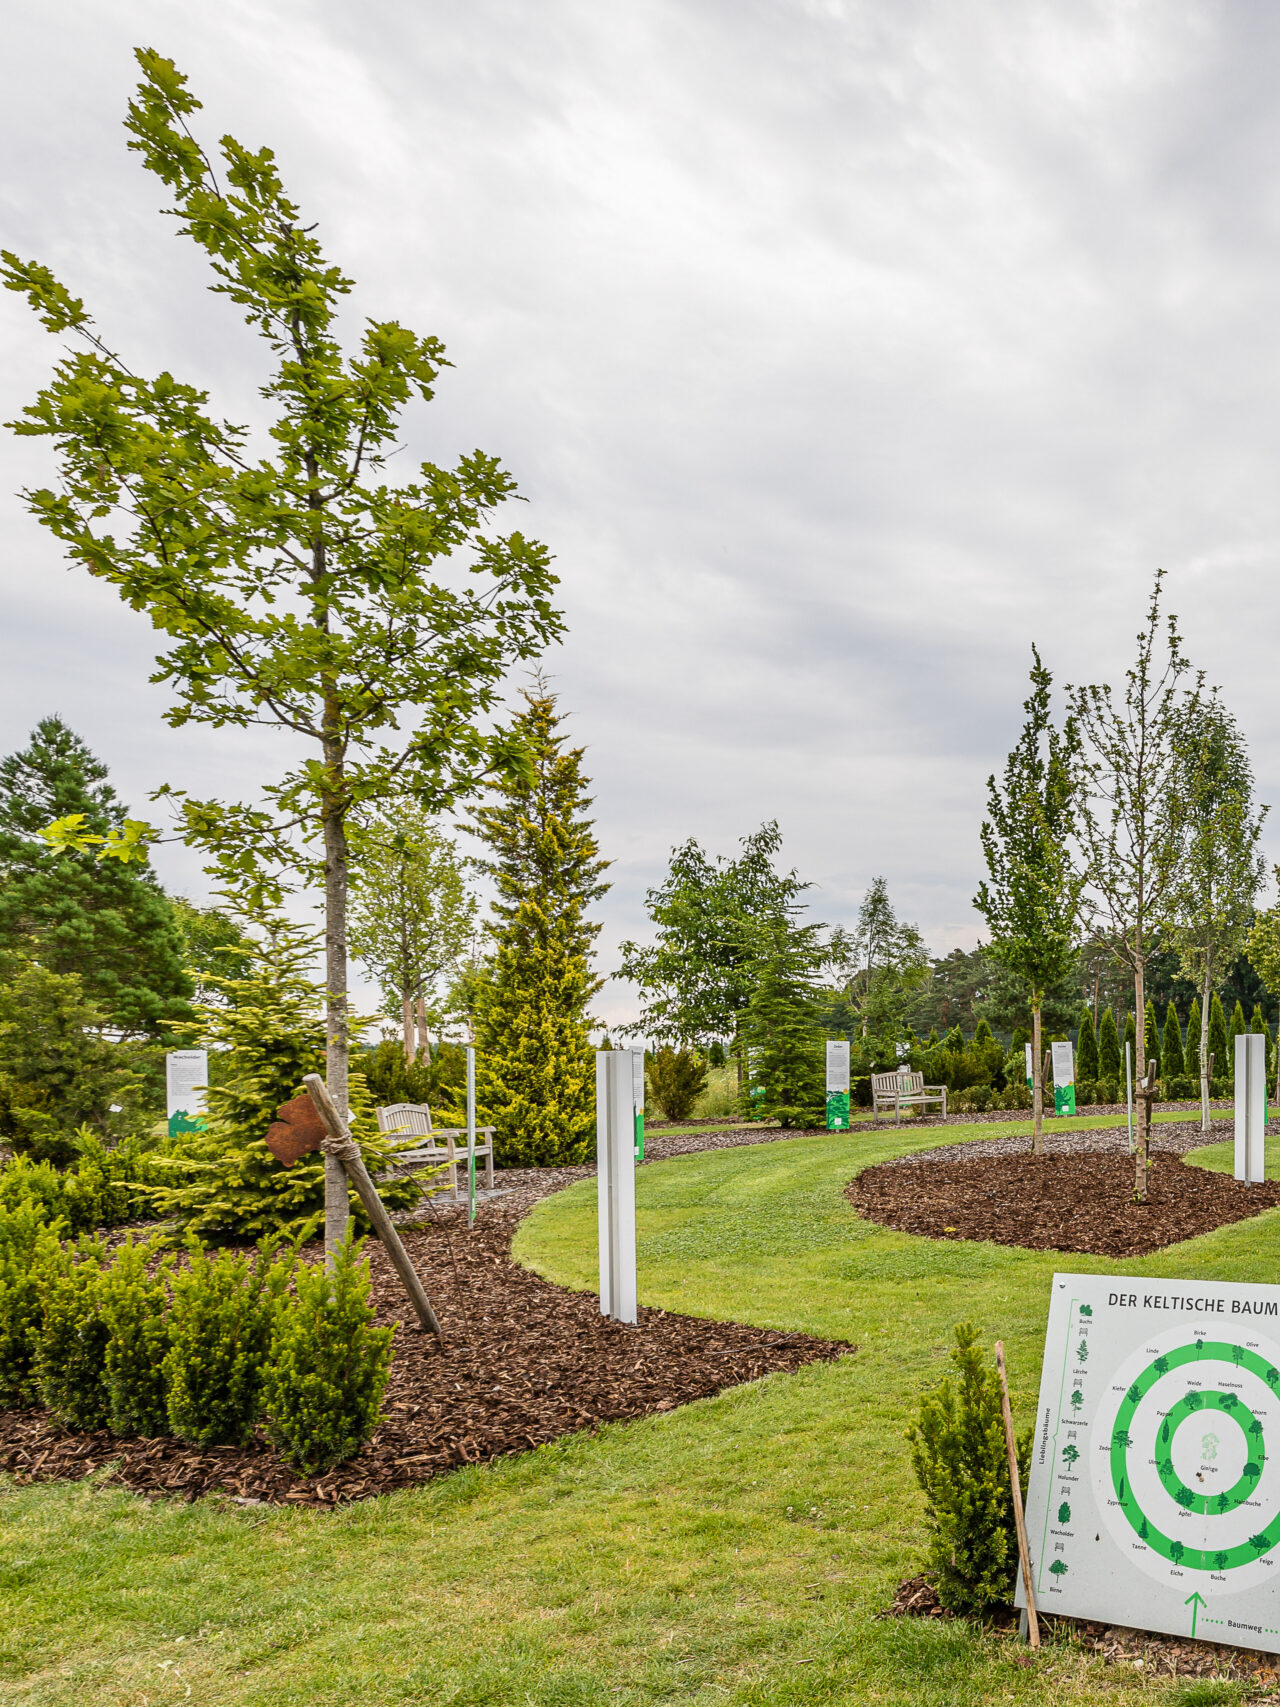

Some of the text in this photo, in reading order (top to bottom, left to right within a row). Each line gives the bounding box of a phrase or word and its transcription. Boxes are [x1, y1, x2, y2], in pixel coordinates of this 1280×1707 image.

[1108, 1293, 1138, 1307] DER
[1143, 1295, 1225, 1313] KELTISCHE
[1038, 1407, 1051, 1465] Lieblingsbäume
[1260, 1557, 1274, 1566] Feige
[1170, 1569, 1183, 1577] Eiche
[1228, 1619, 1262, 1633] Baumweg
